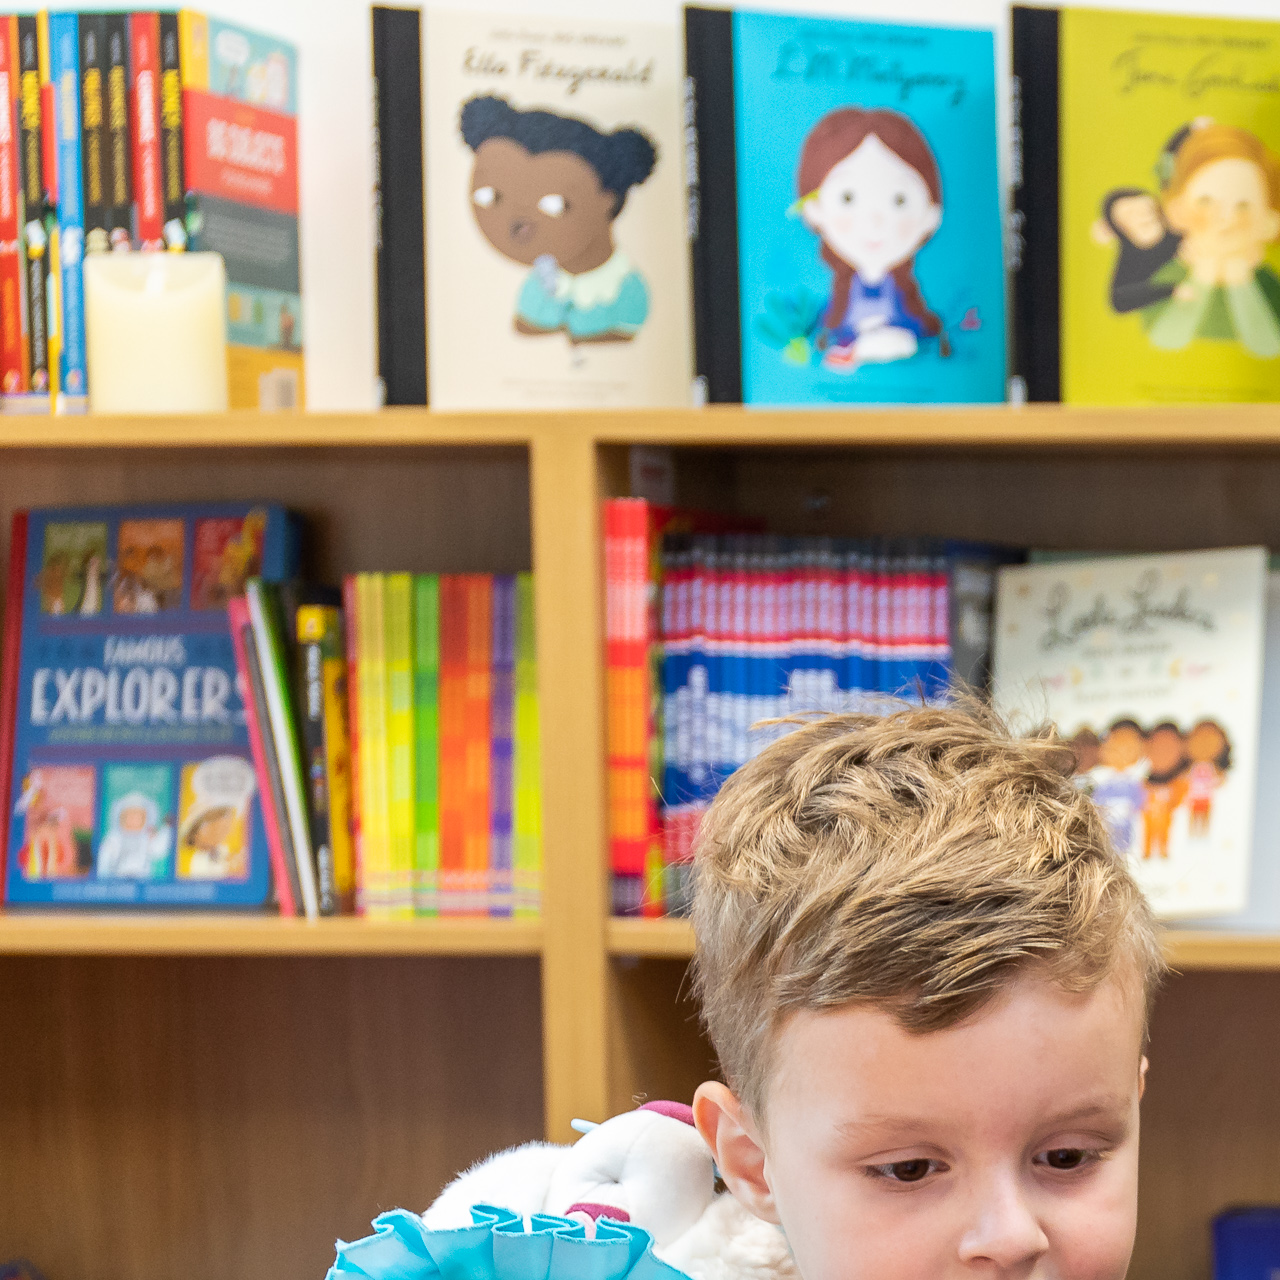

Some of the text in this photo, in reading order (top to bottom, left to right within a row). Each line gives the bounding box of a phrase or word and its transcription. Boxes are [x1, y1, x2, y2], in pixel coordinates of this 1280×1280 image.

[463, 45, 656, 96] Ella Fitzgerald
[104, 635, 187, 667] FAMOUS
